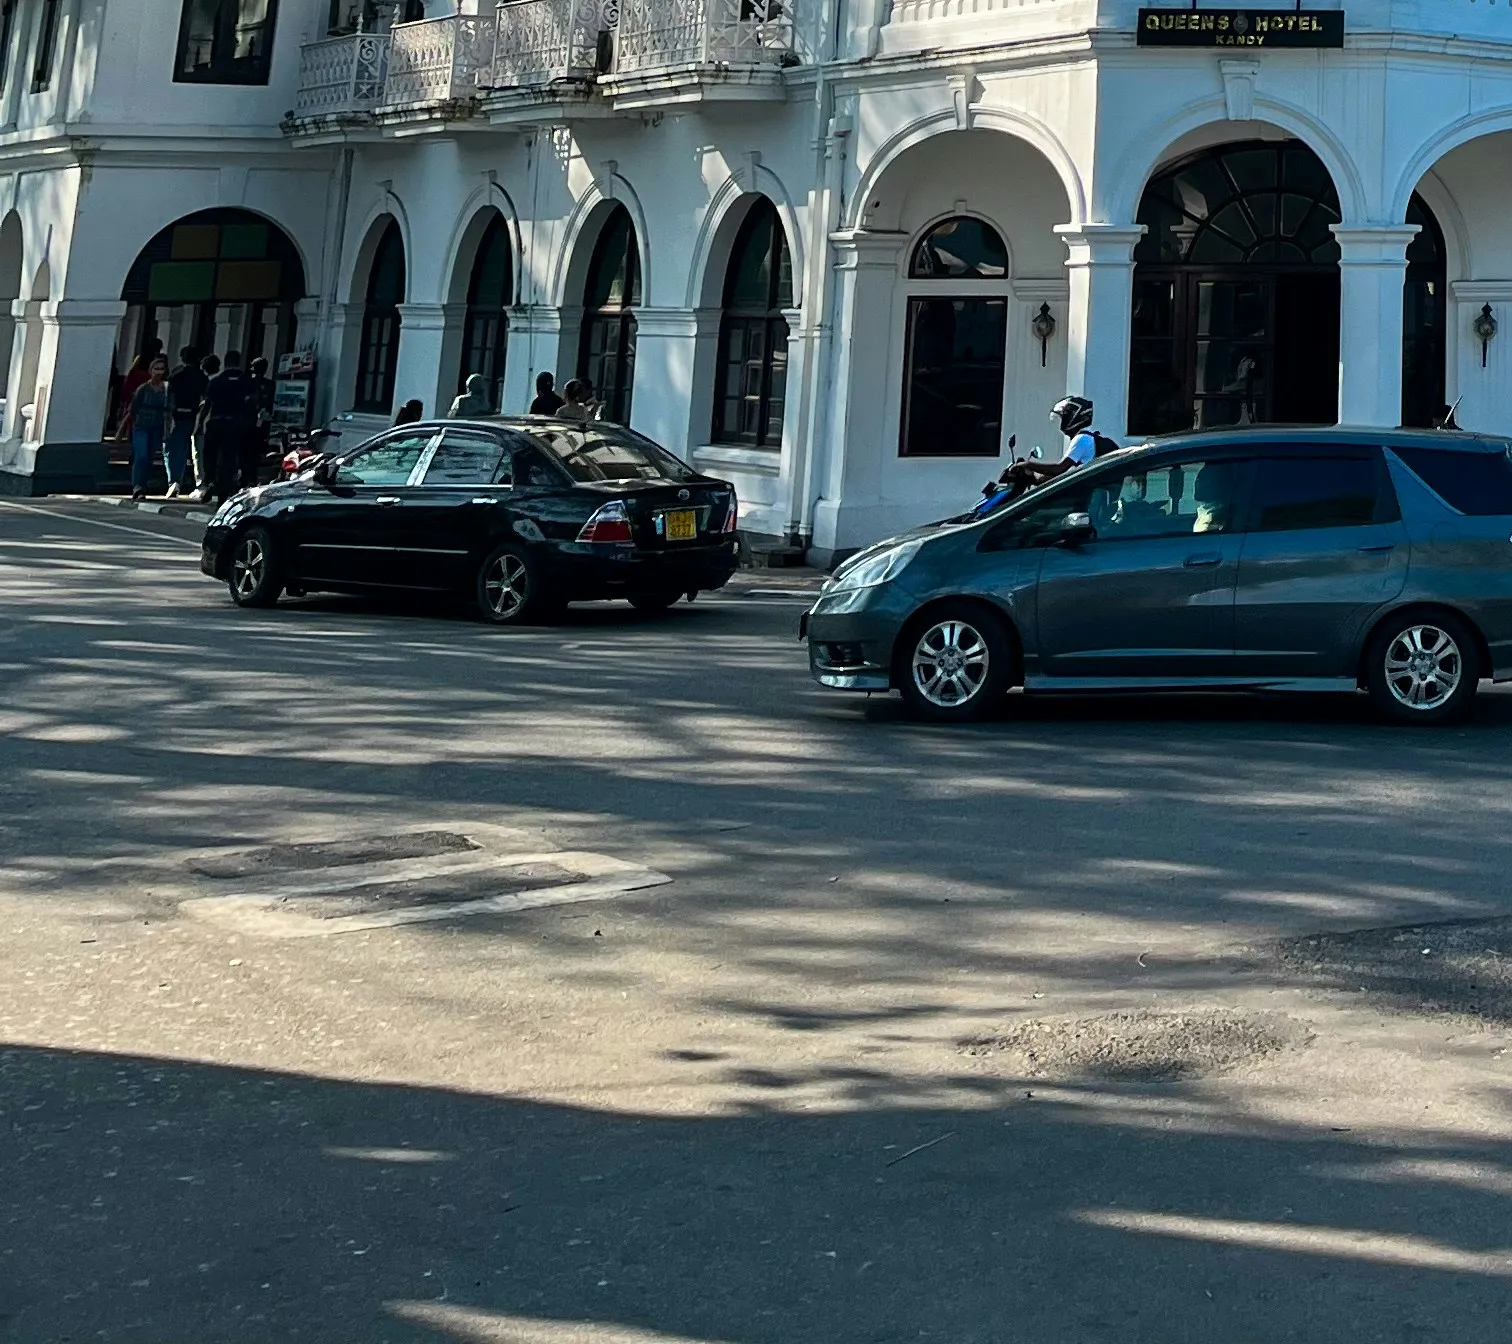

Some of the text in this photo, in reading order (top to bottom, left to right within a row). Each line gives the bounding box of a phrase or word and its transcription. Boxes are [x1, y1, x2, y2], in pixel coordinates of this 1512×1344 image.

[1145, 14, 1323, 32] QUEENS HOTEL
[1215, 35, 1265, 46] KANDY
